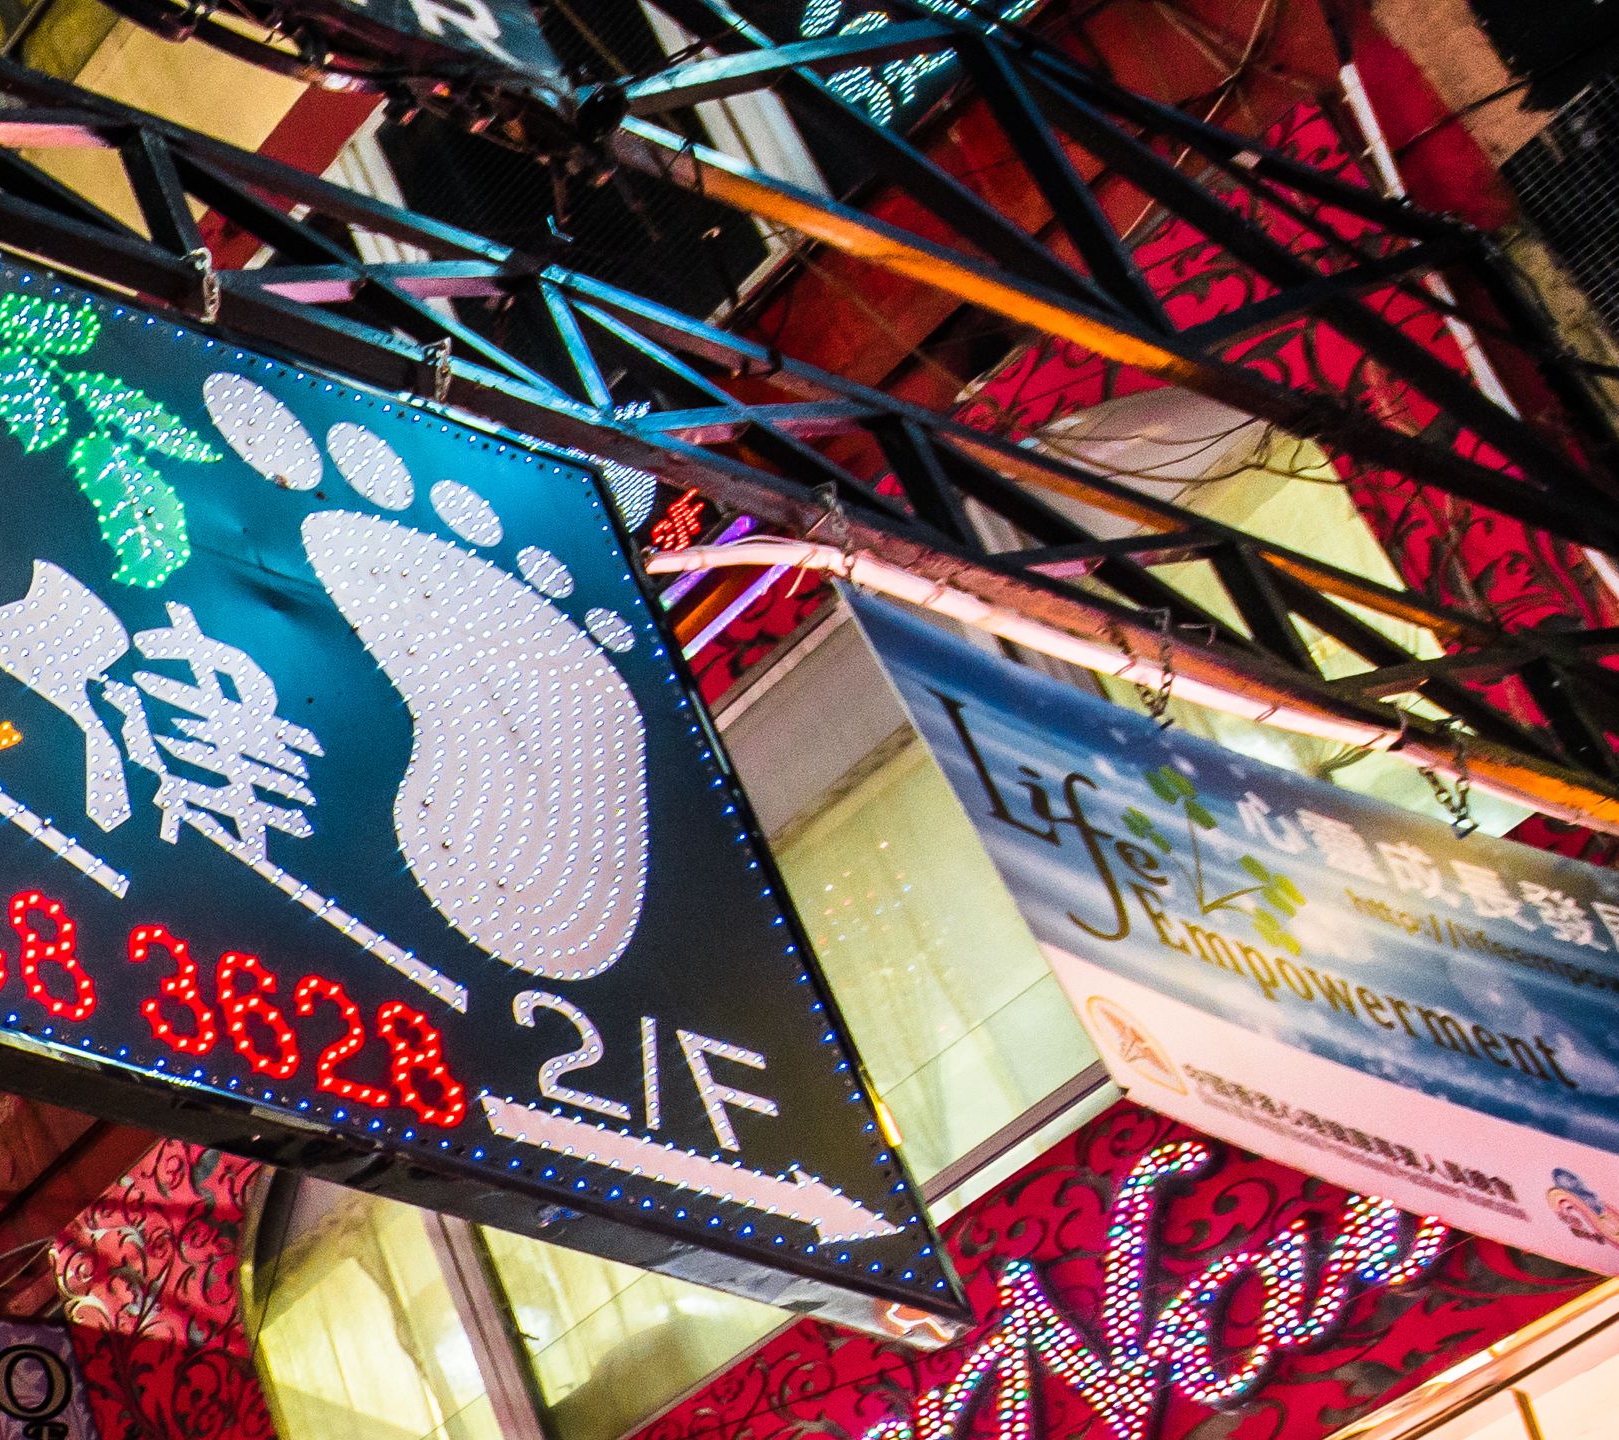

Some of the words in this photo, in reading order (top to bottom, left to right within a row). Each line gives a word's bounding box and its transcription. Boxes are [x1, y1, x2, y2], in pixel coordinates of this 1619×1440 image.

[924, 675, 1168, 942] Life
[128, 925, 468, 1130] 3628
[510, 988, 781, 1153] 2/F
[1148, 880, 1583, 1089] Empowerment
